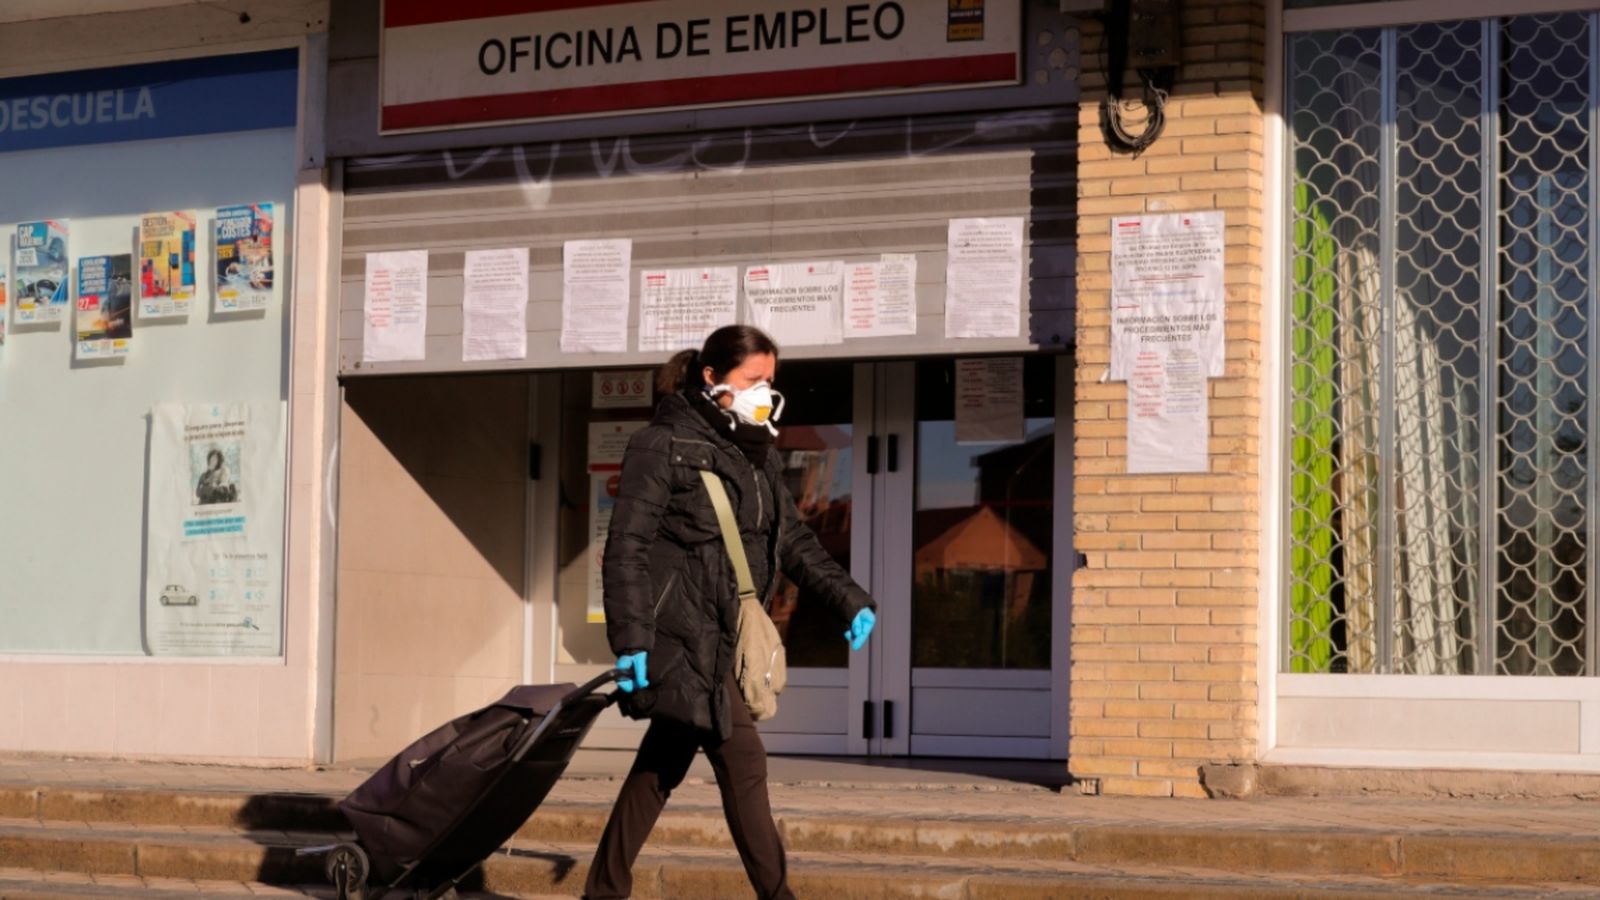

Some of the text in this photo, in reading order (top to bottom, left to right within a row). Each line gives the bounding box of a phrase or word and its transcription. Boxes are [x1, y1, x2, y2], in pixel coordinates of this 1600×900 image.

[479, 1, 905, 75] OFICINA DE EMPLEO
[824, 285, 839, 293] LOS
[770, 304, 816, 312] FRECUENTES
[1173, 313, 1197, 322] SOBRE
[1200, 313, 1217, 321] LOS
[1124, 325, 1192, 334] PROCEDIMIENTOS
[1141, 335, 1192, 343] FRECUENTES
